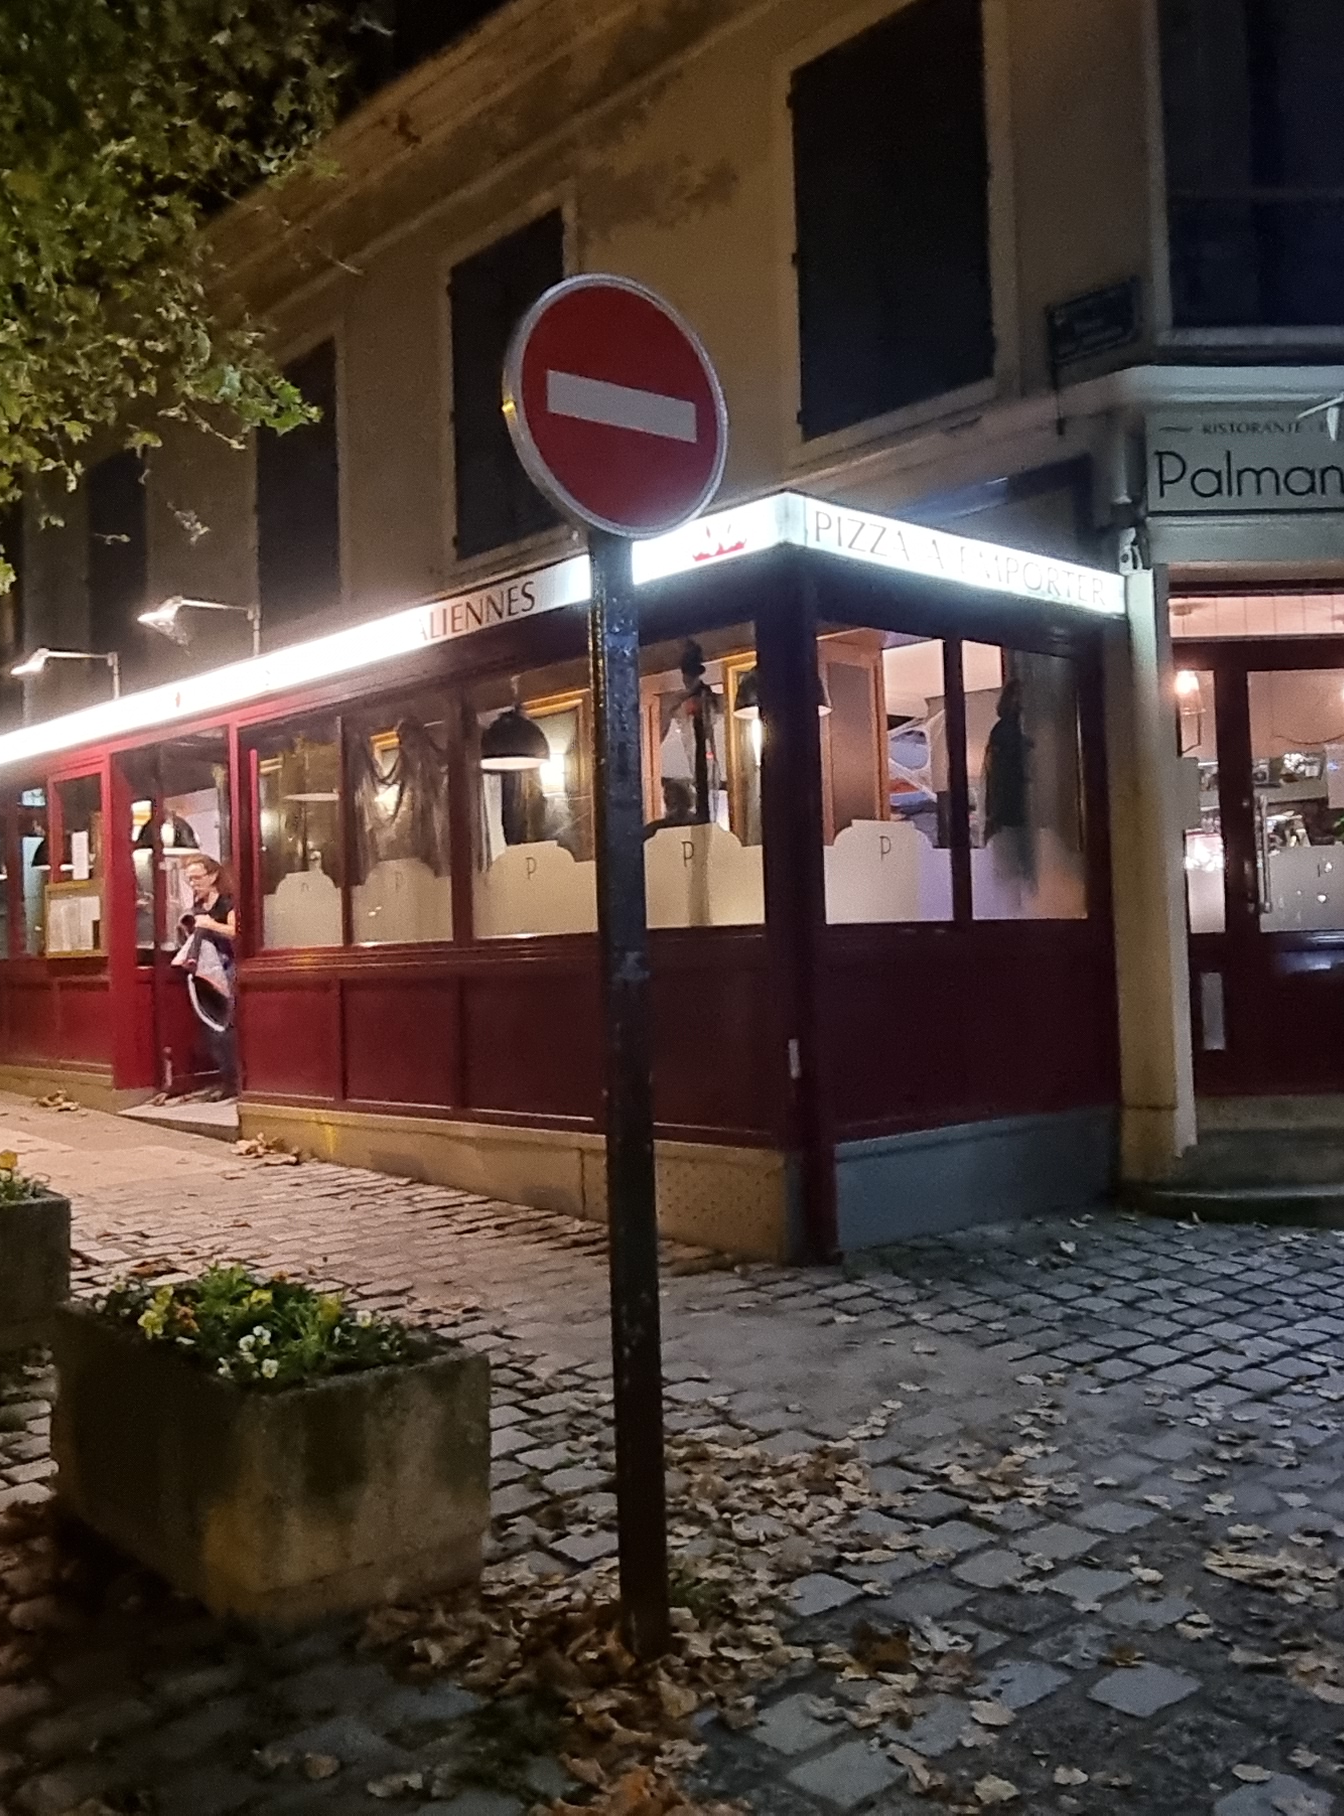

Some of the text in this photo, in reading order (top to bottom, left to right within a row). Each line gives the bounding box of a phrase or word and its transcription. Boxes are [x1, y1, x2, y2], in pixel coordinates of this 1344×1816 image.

[1202, 420, 1302, 435] RISTORANTE
[815, 510, 911, 564] PIZZA
[960, 546, 1107, 607] EMPORTER
[681, 841, 695, 867] P
[878, 835, 892, 861] P
[525, 857, 538, 880] P
